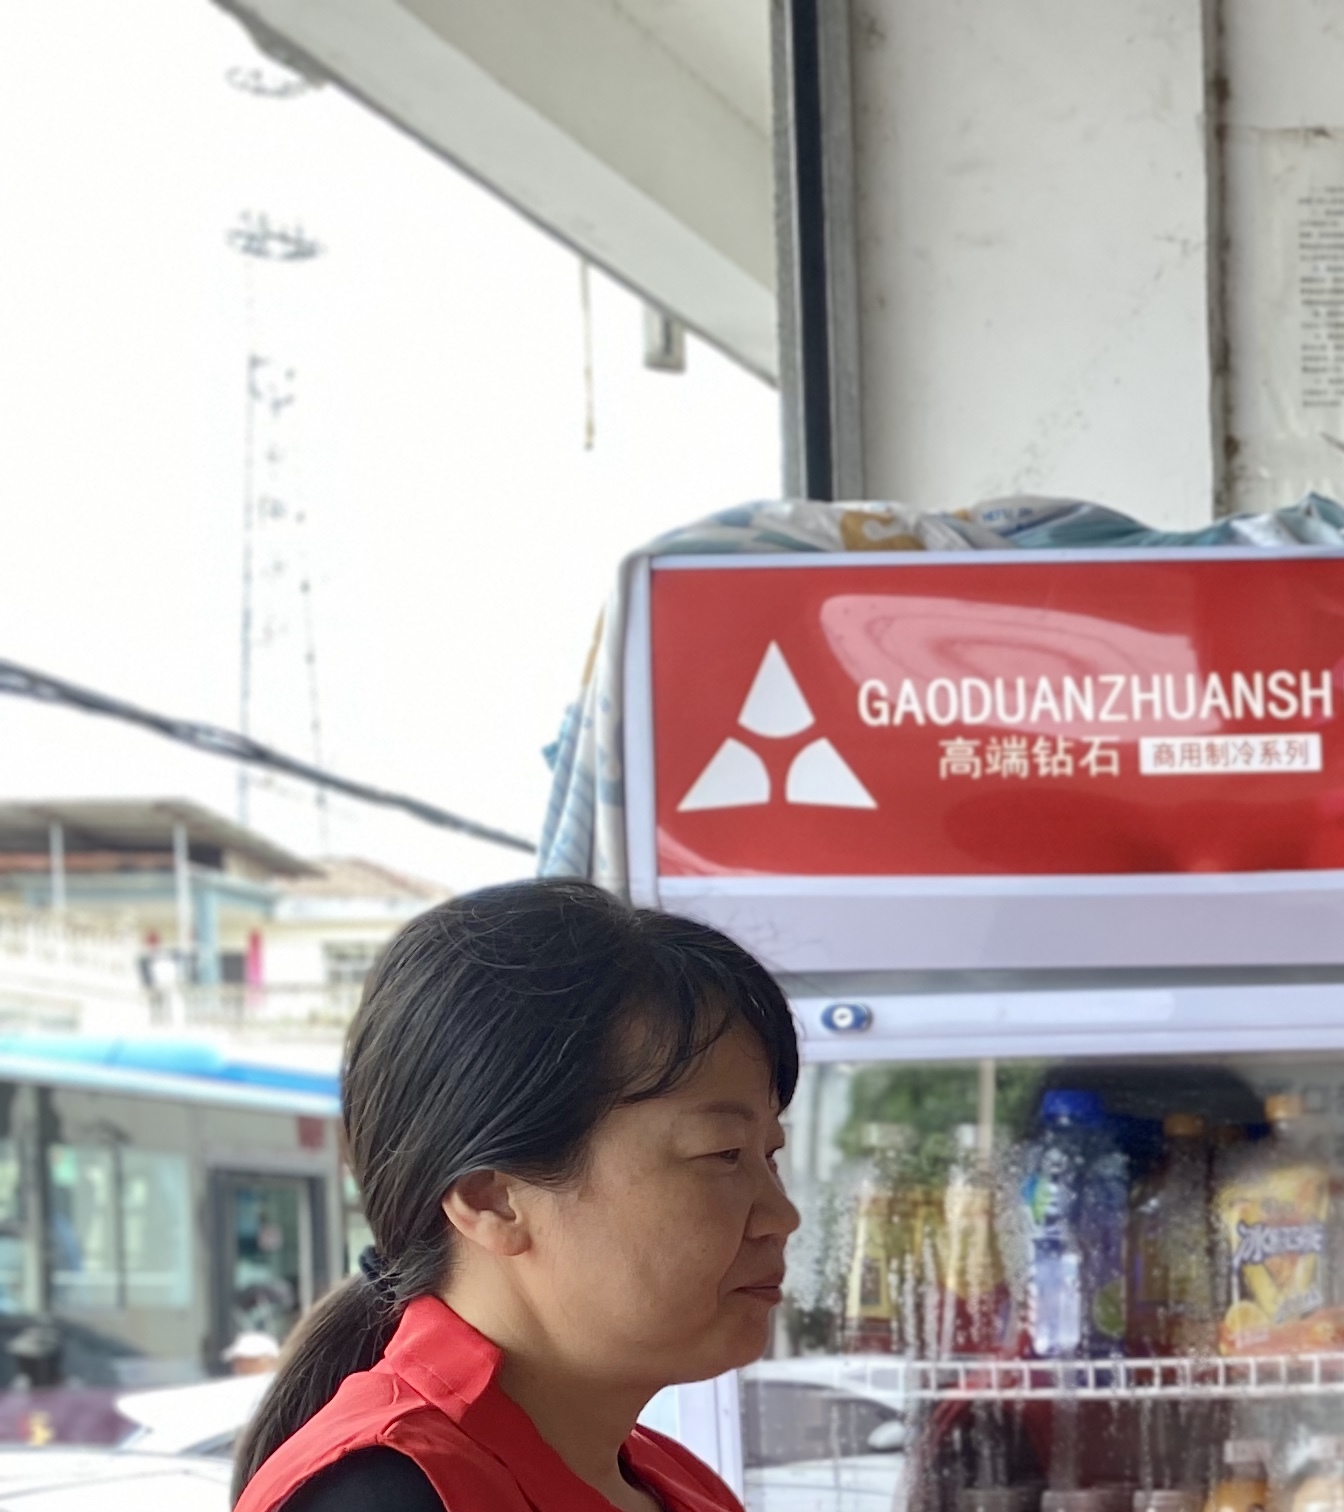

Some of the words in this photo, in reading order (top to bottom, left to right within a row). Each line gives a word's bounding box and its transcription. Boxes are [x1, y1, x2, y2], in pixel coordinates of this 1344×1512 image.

[937, 735, 1121, 780] 高端钻石
[1150, 740, 1311, 769] 商用制冷系列
